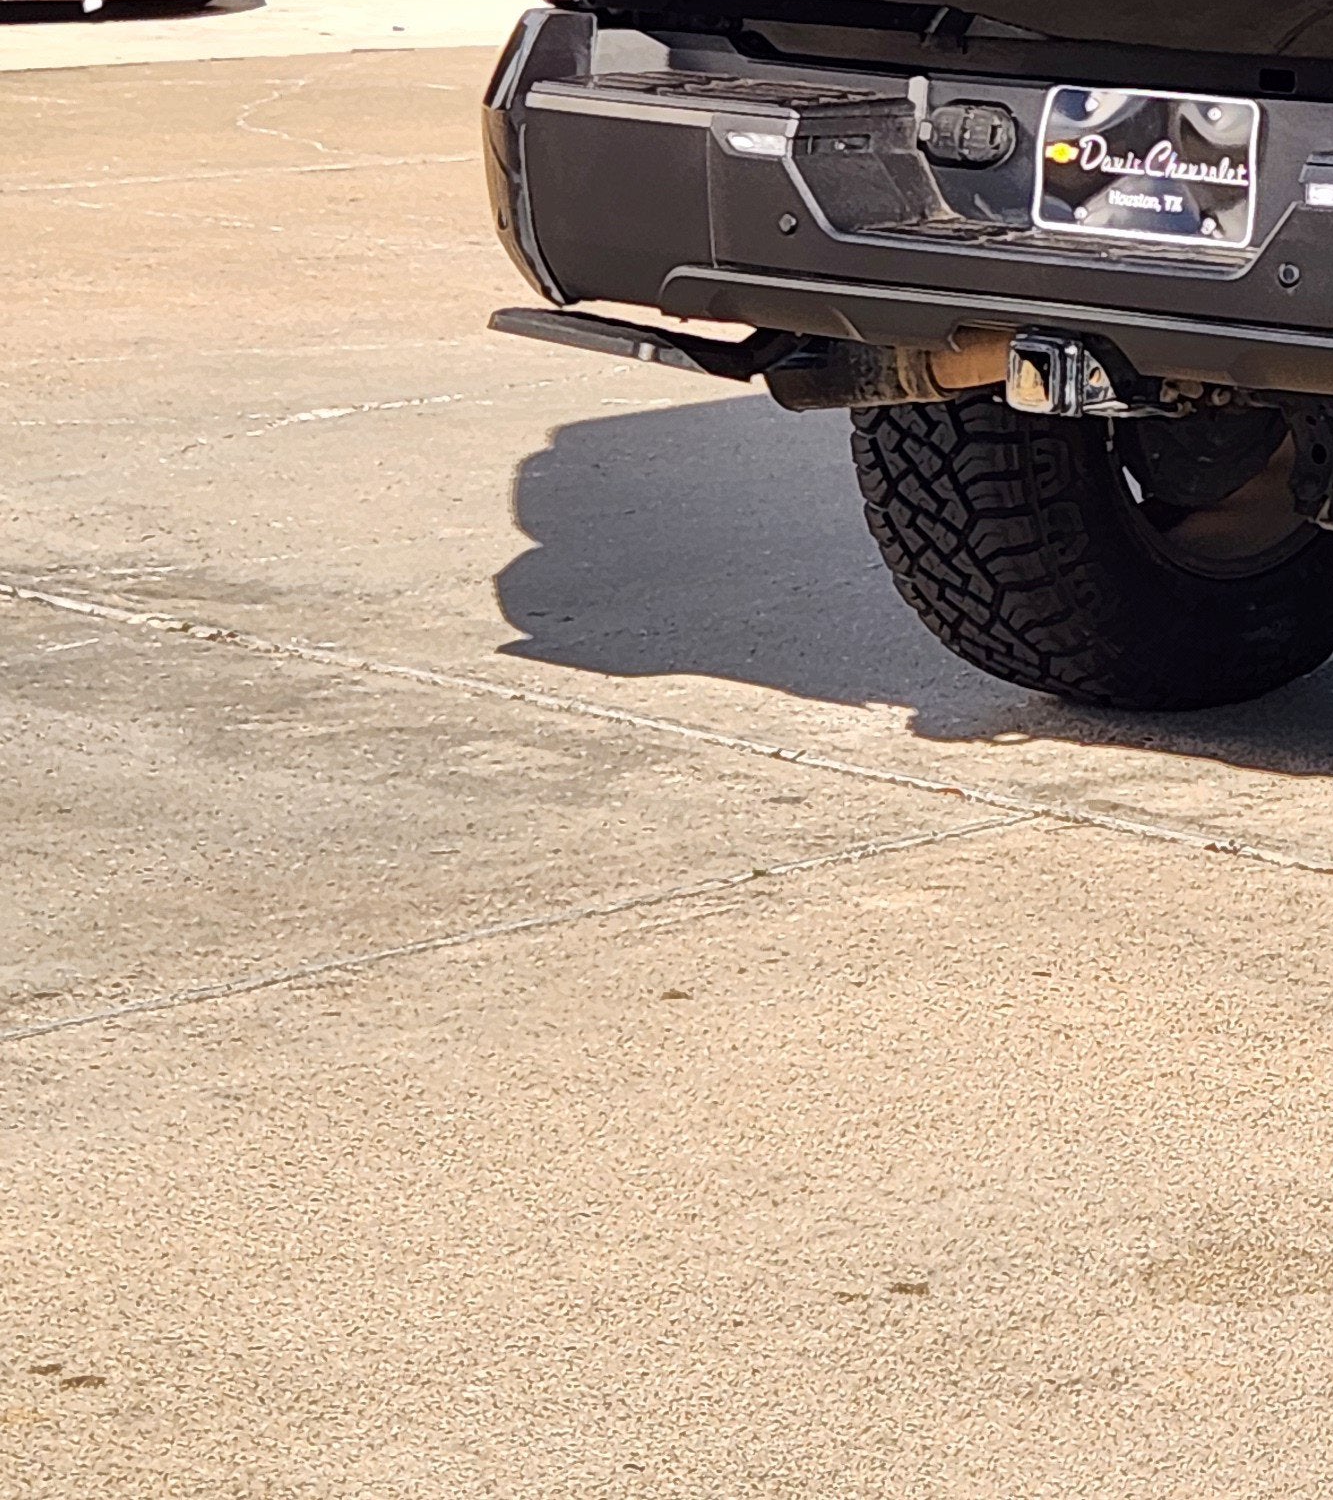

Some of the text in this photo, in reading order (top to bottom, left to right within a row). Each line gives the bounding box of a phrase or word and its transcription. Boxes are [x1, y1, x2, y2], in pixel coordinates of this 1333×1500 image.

[1078, 134, 1249, 187] Davis Chevrolet
[1163, 194, 1183, 214] TX
